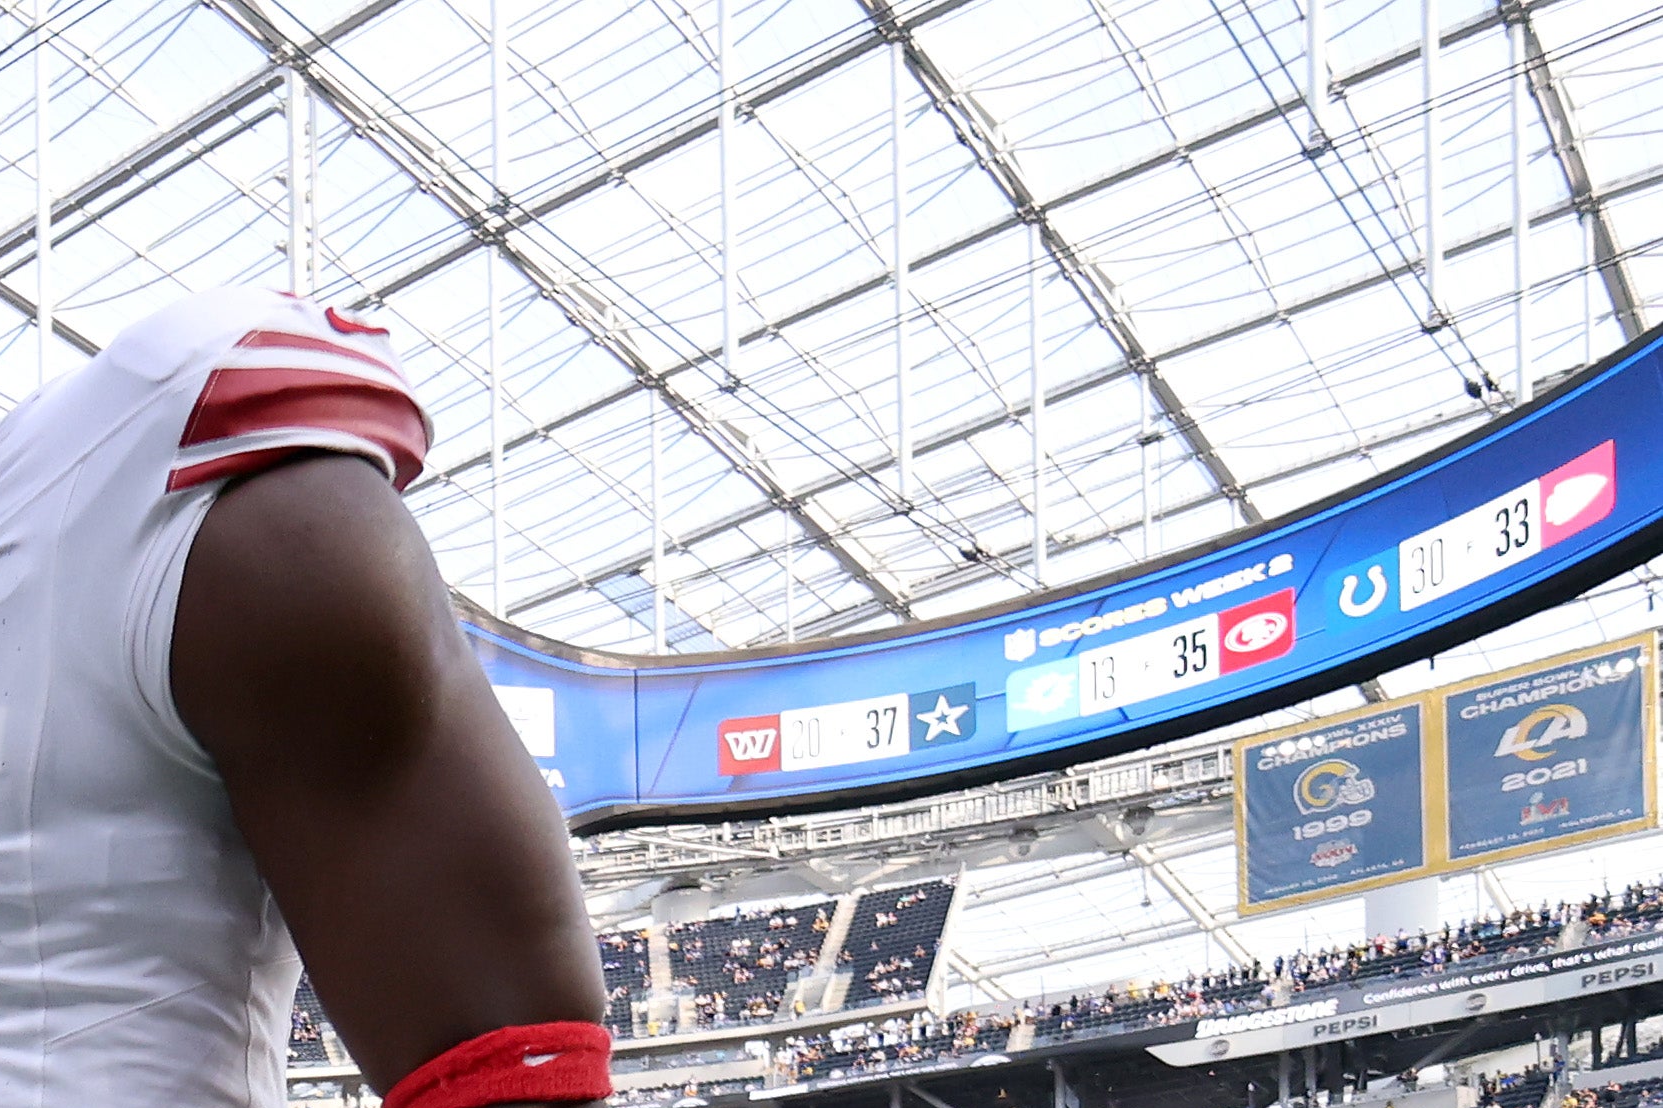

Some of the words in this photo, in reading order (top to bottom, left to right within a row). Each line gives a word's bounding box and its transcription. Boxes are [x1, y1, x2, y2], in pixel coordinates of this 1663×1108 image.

[1412, 538, 1444, 594] 30
[1496, 498, 1529, 557] 33
[1039, 597, 1168, 646] SCORES
[1171, 563, 1266, 608] WEEK
[1267, 553, 1294, 577] 2
[1091, 656, 1116, 700] 13
[1173, 629, 1207, 678] 35
[792, 718, 820, 758] 20
[867, 707, 897, 749] 37
[1257, 723, 1407, 771] CHAMPIONS
[1501, 758, 1588, 792] 2021
[1292, 809, 1373, 841] 1999
[1363, 982, 1439, 1005] Confidence
[1440, 976, 1470, 990] with
[1471, 970, 1510, 985] every
[1511, 960, 1550, 976] drive,
[1552, 952, 1592, 968] that's
[1594, 945, 1630, 960] what
[1581, 962, 1654, 988] PEPSI
[1195, 998, 1338, 1038] BRIDGESTONE
[1313, 1015, 1377, 1037] PEPSI
